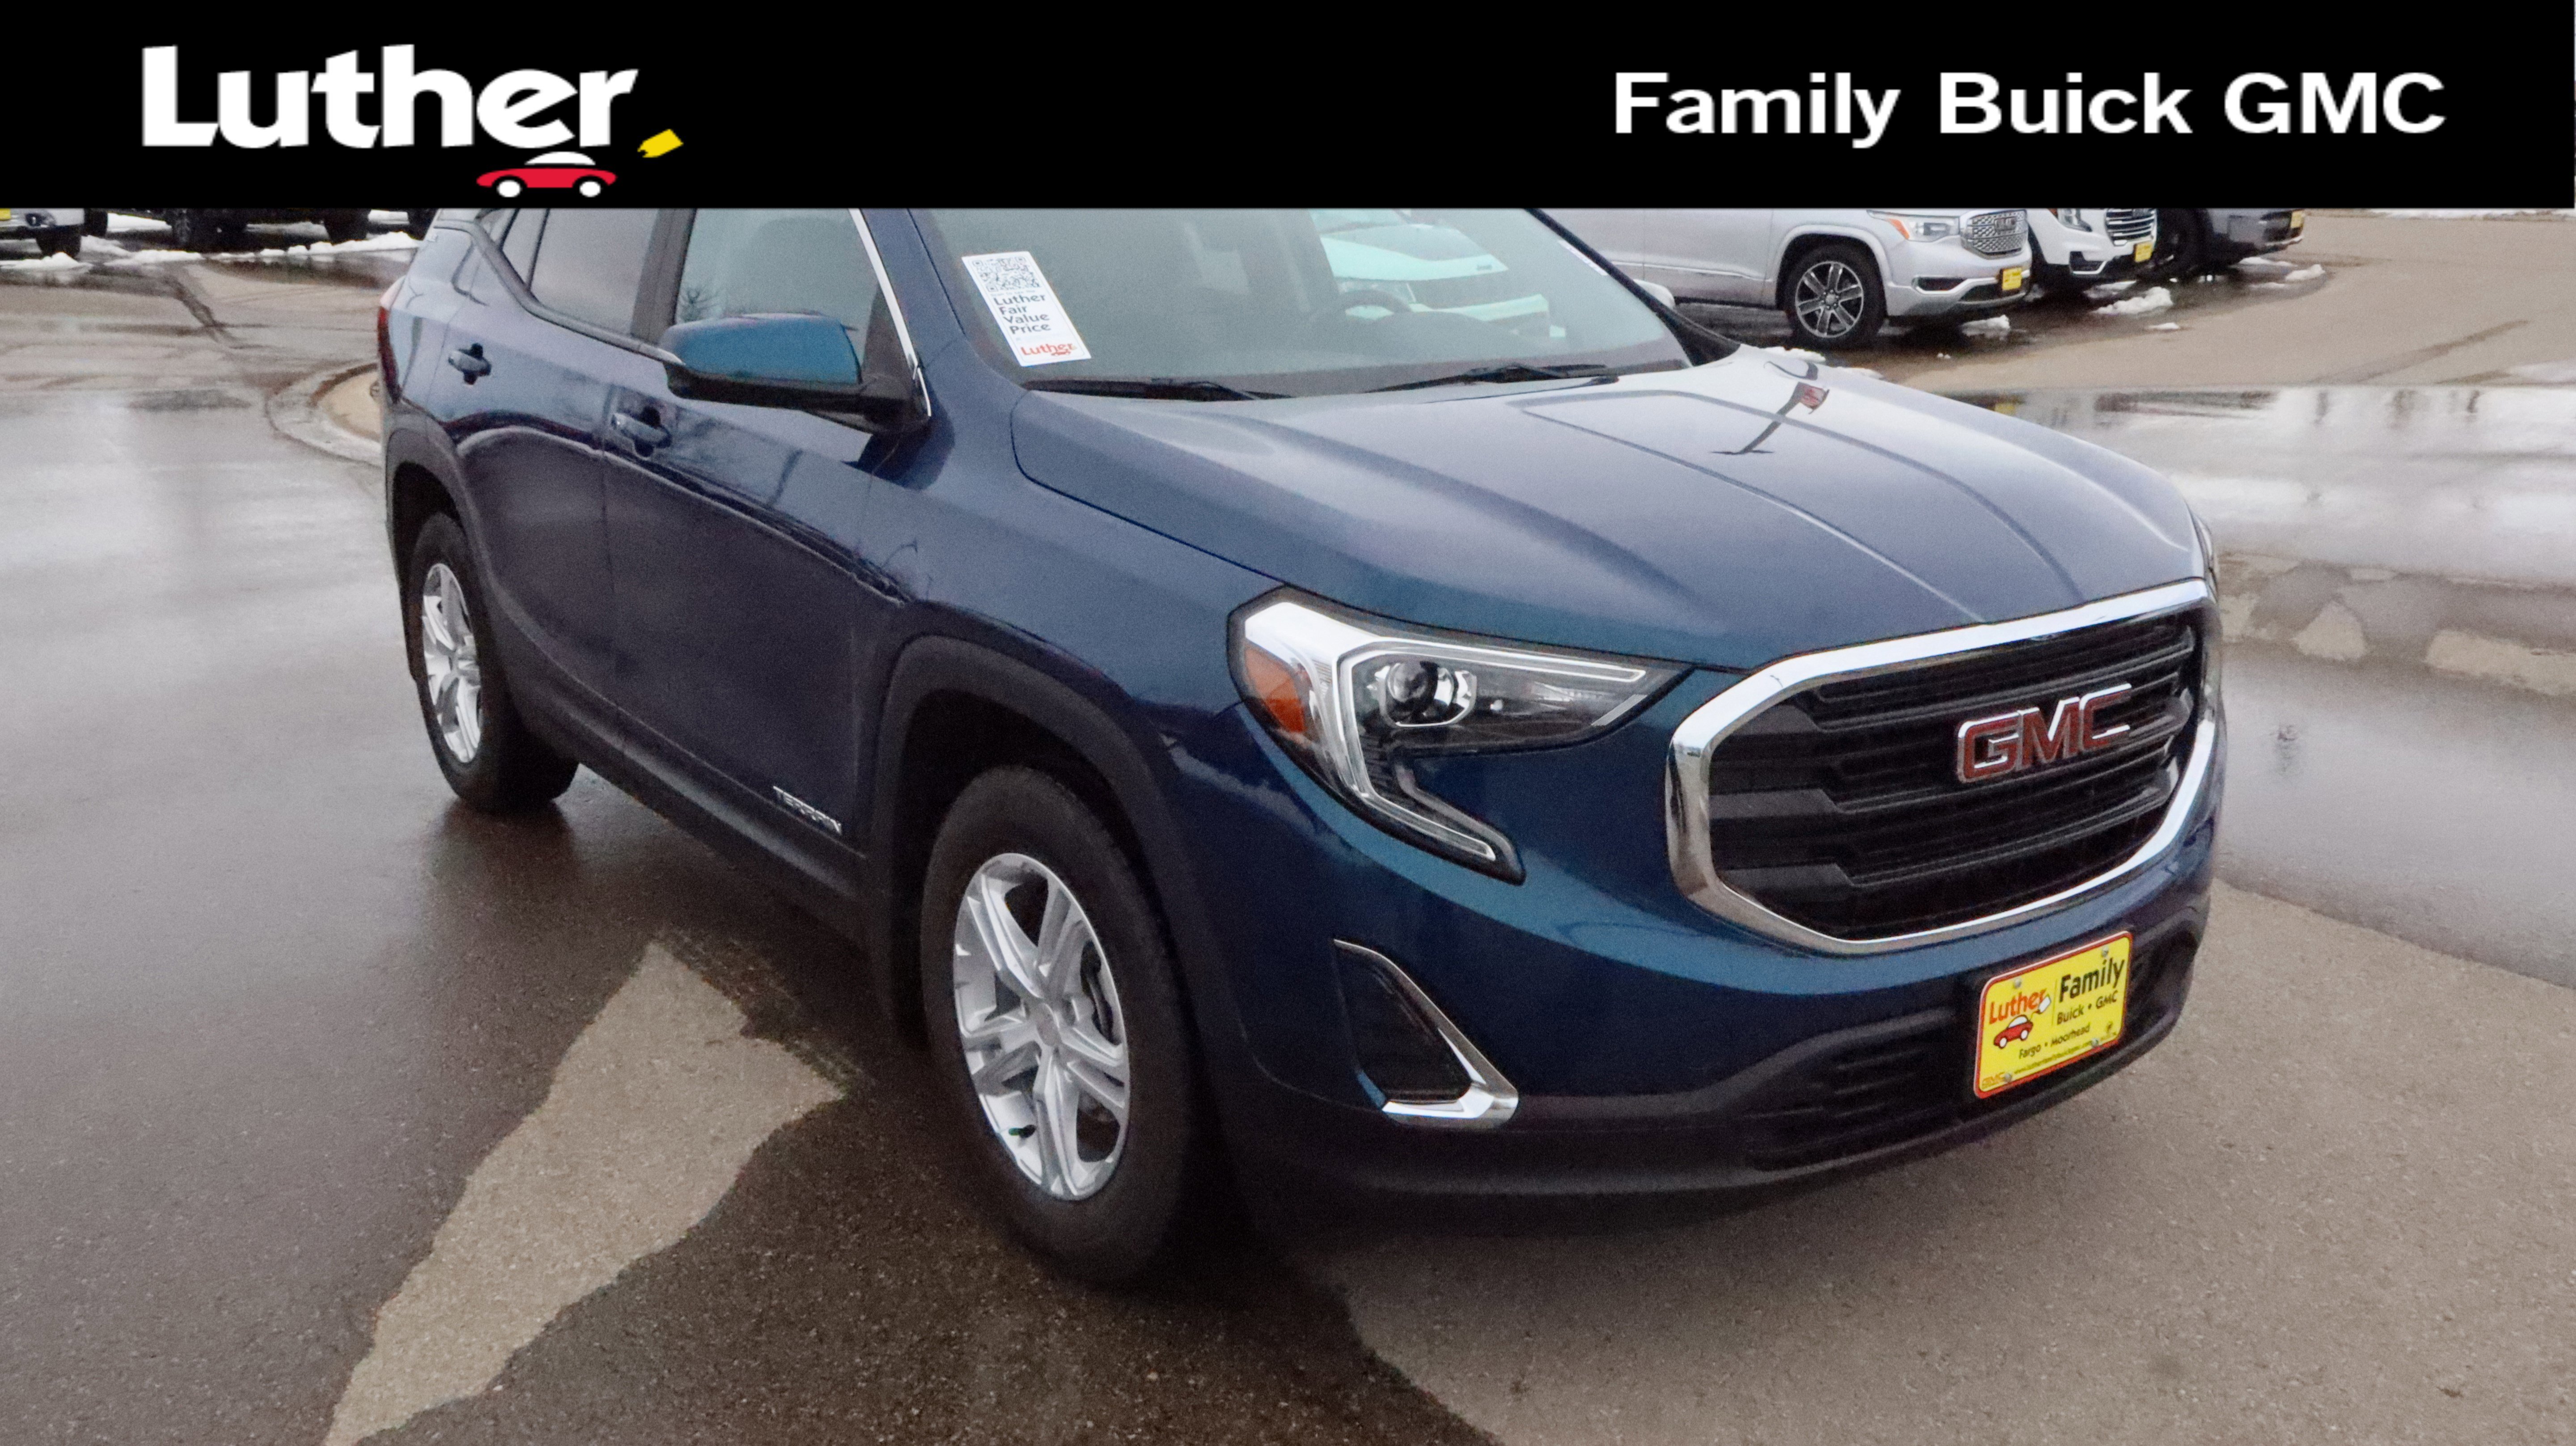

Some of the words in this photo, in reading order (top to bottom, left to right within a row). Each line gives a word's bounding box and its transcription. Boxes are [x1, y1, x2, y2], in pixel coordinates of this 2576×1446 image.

[993, 295, 1046, 305] Luther
[999, 305, 1027, 315] Fair
[1003, 314, 1050, 324] Value
[1009, 324, 1051, 335] Price
[1021, 343, 1073, 356] Luther
[1957, 683, 2132, 783] GMC
[2059, 957, 2125, 1003] Family
[1989, 988, 2047, 1025] Luther
[2057, 1004, 2085, 1025] Buick
[2096, 990, 2118, 1009] GMC
[2019, 1044, 2041, 1059] Fargo
